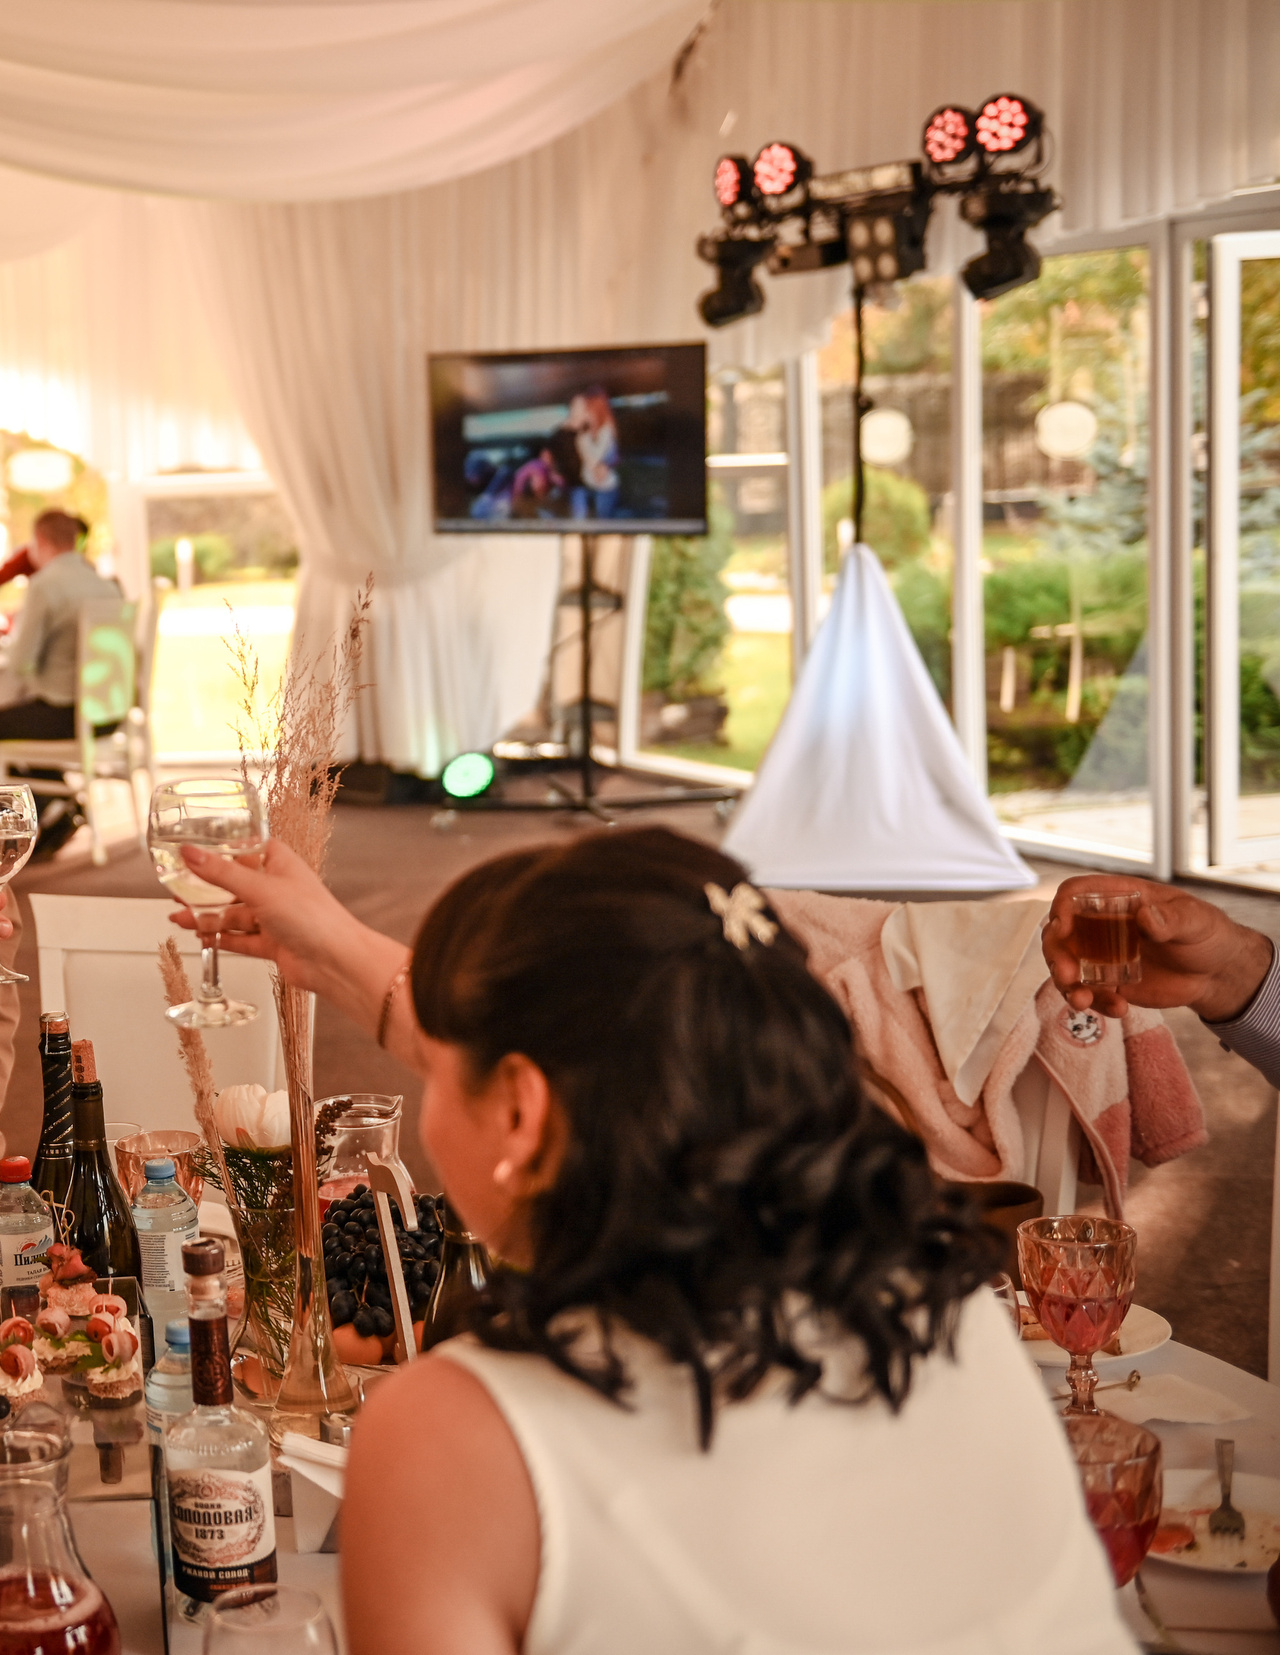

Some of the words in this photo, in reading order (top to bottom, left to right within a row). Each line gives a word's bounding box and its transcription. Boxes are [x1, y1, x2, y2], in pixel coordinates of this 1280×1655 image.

[172, 1504, 253, 1526] СОЛОДОВАЯ
[195, 1528, 224, 1539] 1873
[218, 1567, 248, 1579] СОЛОД
